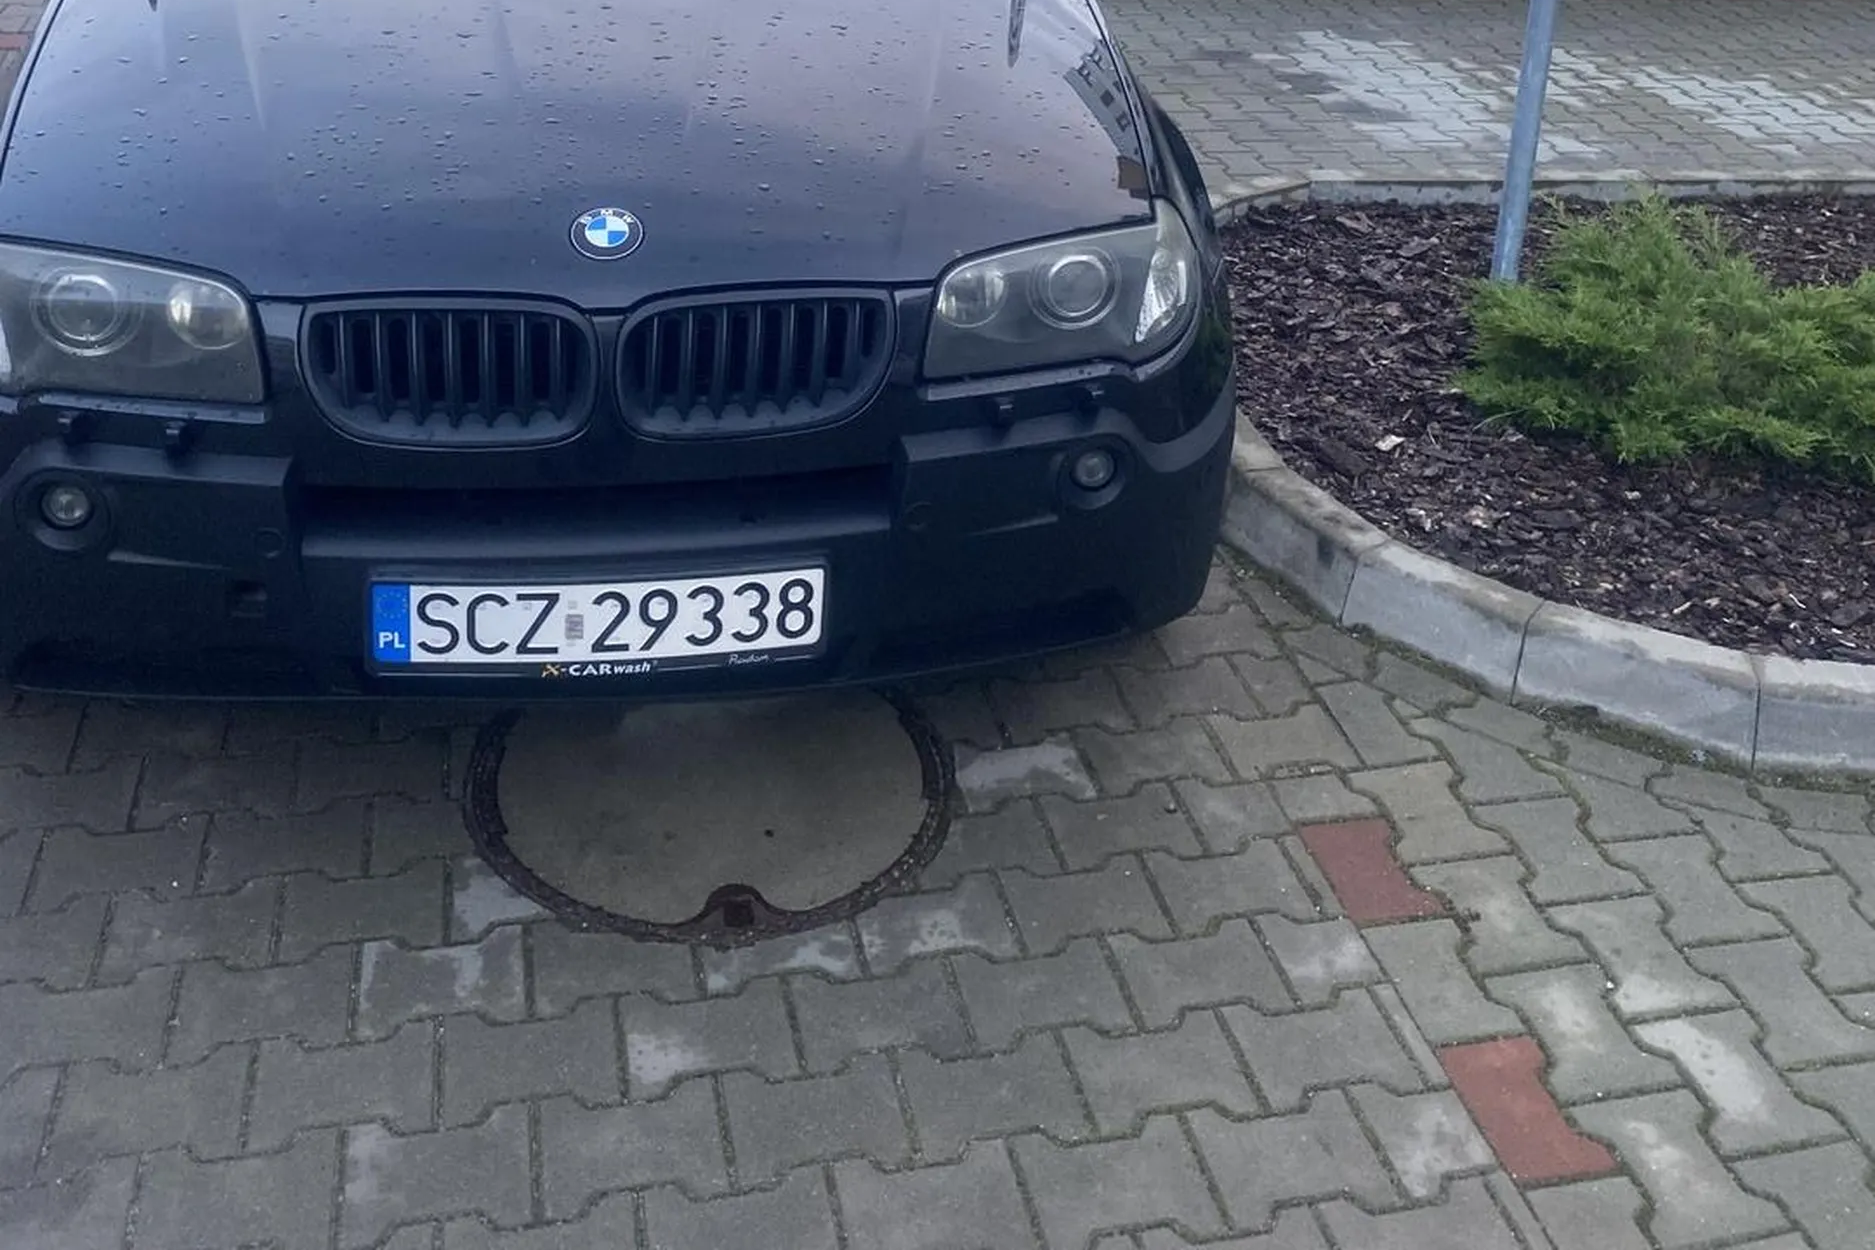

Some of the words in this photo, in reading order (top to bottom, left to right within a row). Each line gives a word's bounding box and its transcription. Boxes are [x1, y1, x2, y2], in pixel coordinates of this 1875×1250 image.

[416, 592, 561, 655] SCZ
[590, 578, 815, 652] 29338
[379, 632, 405, 648] PL
